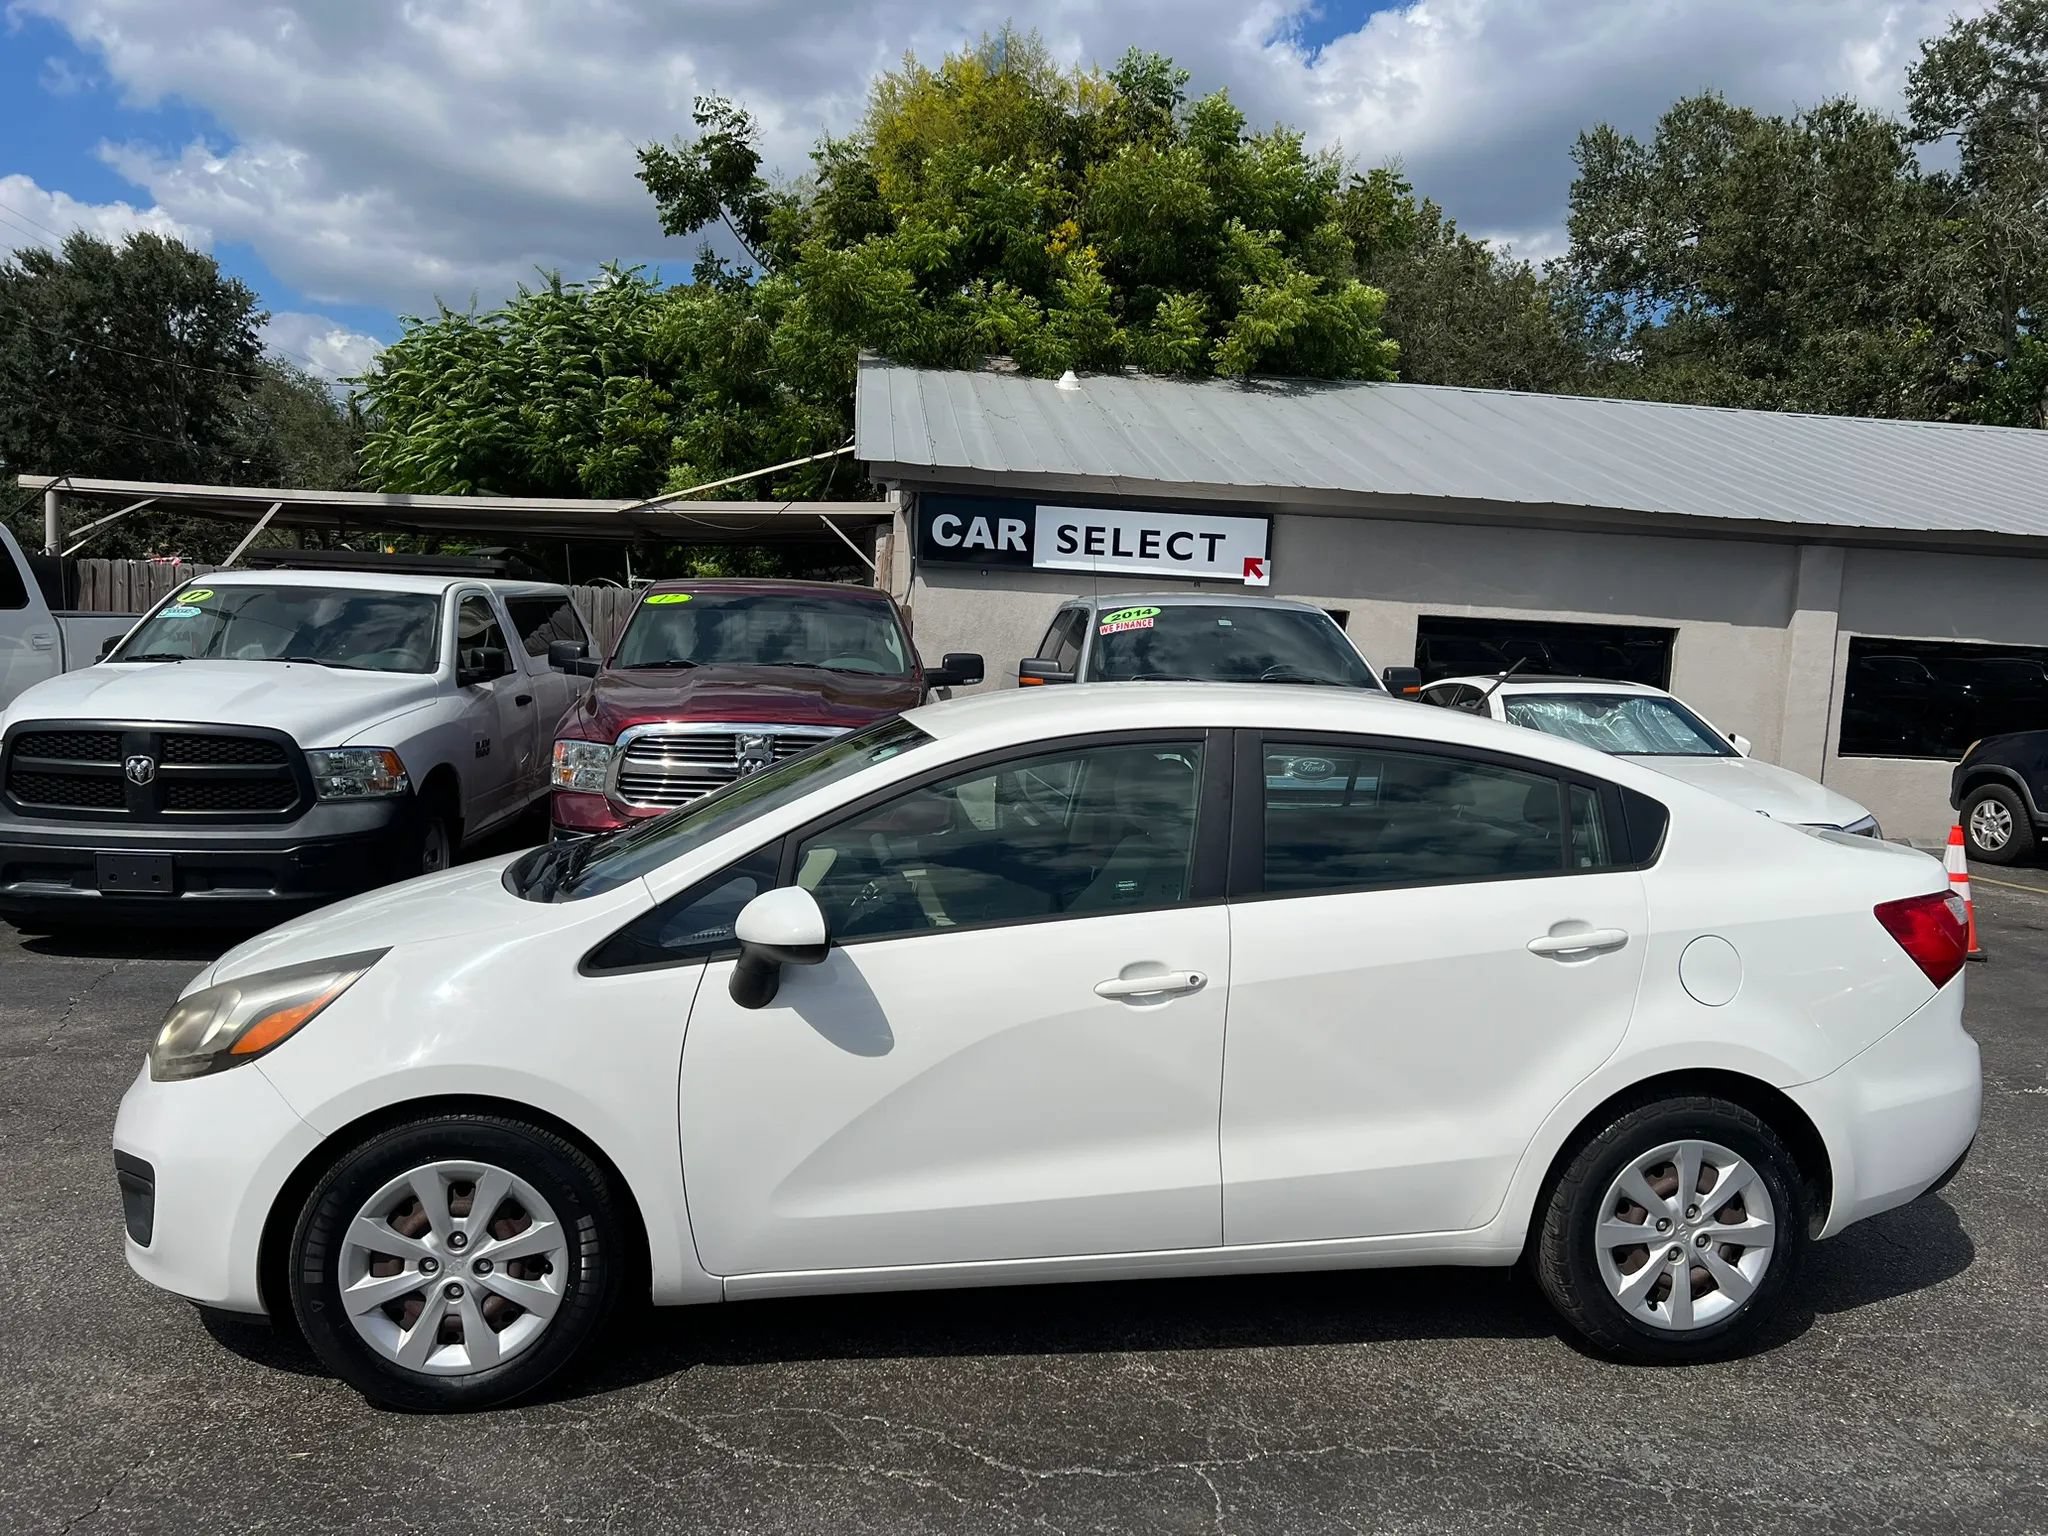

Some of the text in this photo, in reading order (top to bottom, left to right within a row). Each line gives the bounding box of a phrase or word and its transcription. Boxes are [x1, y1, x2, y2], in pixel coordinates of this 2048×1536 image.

[931, 513, 1227, 563] CAR SELECT
[1110, 608, 1153, 622] 2014
[1100, 619, 1153, 634] WE FINANCE
[1300, 760, 1326, 773] Ford
